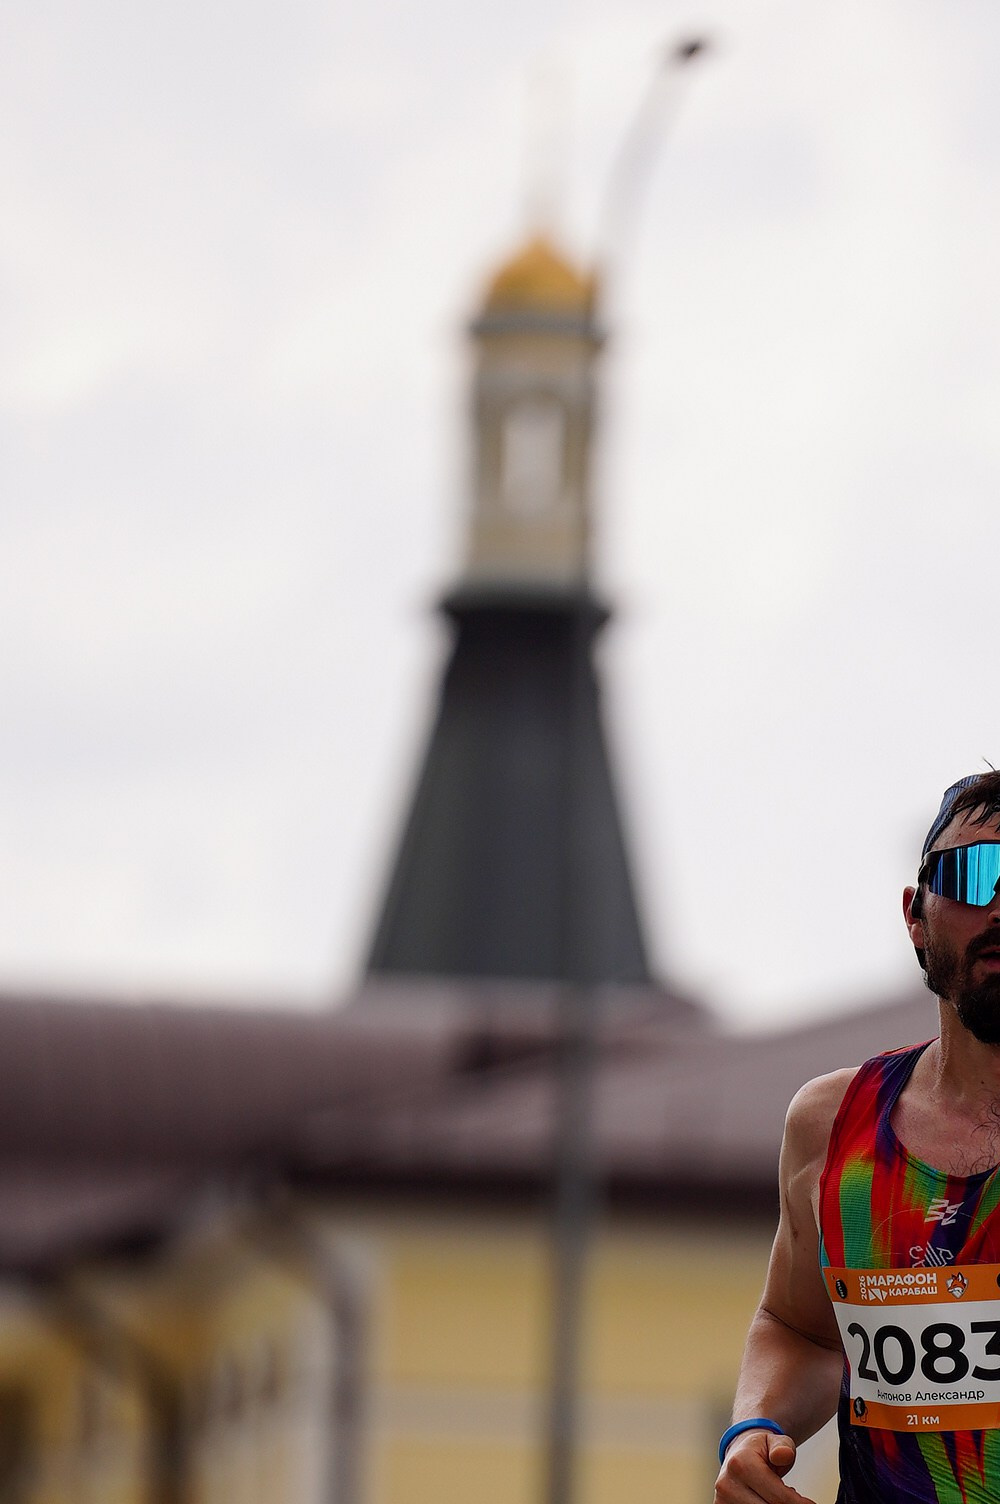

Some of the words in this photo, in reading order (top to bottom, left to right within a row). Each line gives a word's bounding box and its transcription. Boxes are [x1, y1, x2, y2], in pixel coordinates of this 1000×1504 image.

[866, 1273, 937, 1287] МАРАФОН
[858, 1275, 868, 1300] 2026
[889, 1286, 938, 1296] КАРАБАШ
[877, 1389, 912, 1402] Антонов
[915, 1389, 985, 1402] Александр
[906, 1414, 918, 1426] 21
[922, 1415, 940, 1425] км
